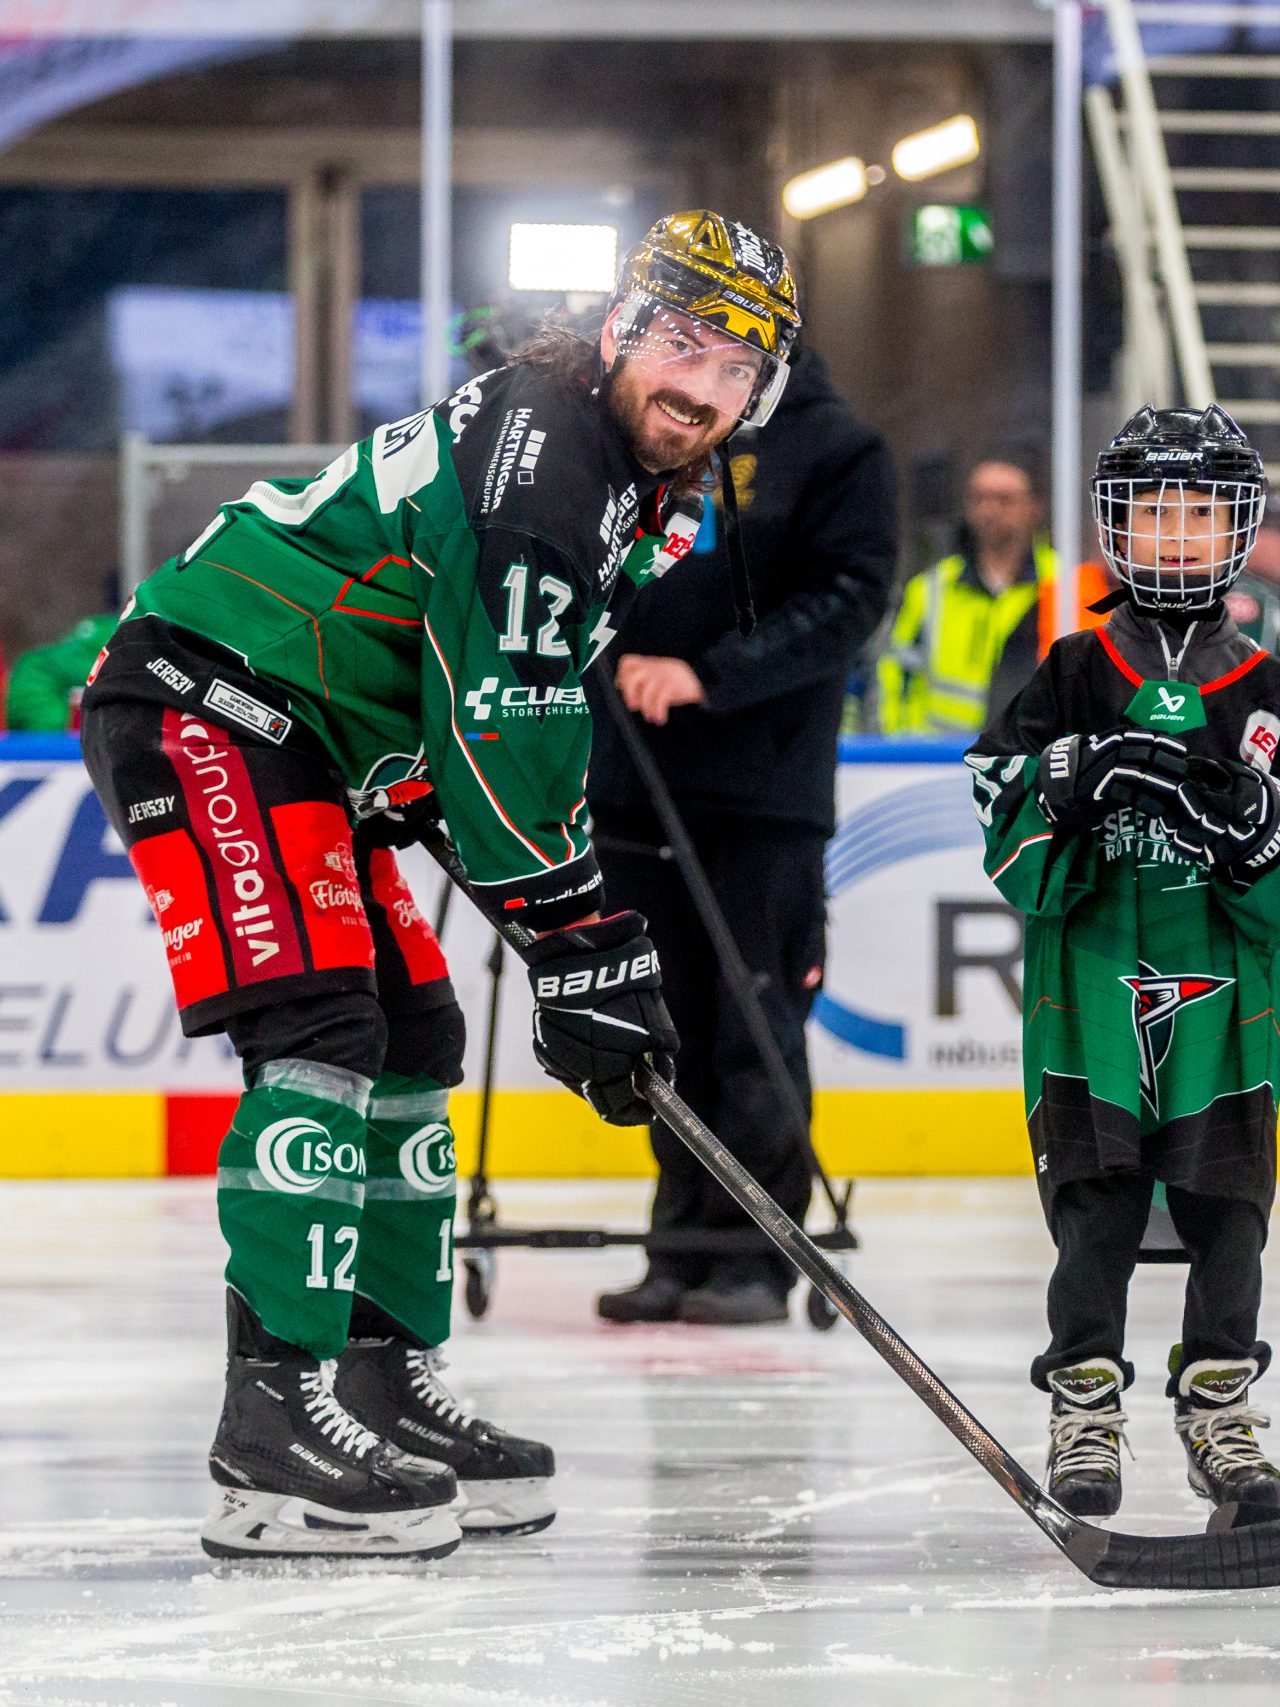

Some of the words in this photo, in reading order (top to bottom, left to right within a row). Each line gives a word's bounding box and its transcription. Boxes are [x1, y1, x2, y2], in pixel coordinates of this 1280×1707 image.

[722, 289, 773, 321] BAUER
[1146, 452, 1204, 462] BAUER
[499, 565, 573, 657] 12
[502, 707, 542, 717] STORE
[545, 706, 590, 716] CHIEMS
[1150, 714, 1186, 722] BAUER
[183, 744, 280, 968] vitagroup
[537, 950, 662, 998] BAUER
[306, 1223, 359, 1292] 12
[436, 1218, 451, 1282] 1
[289, 1442, 344, 1480] BAUER
